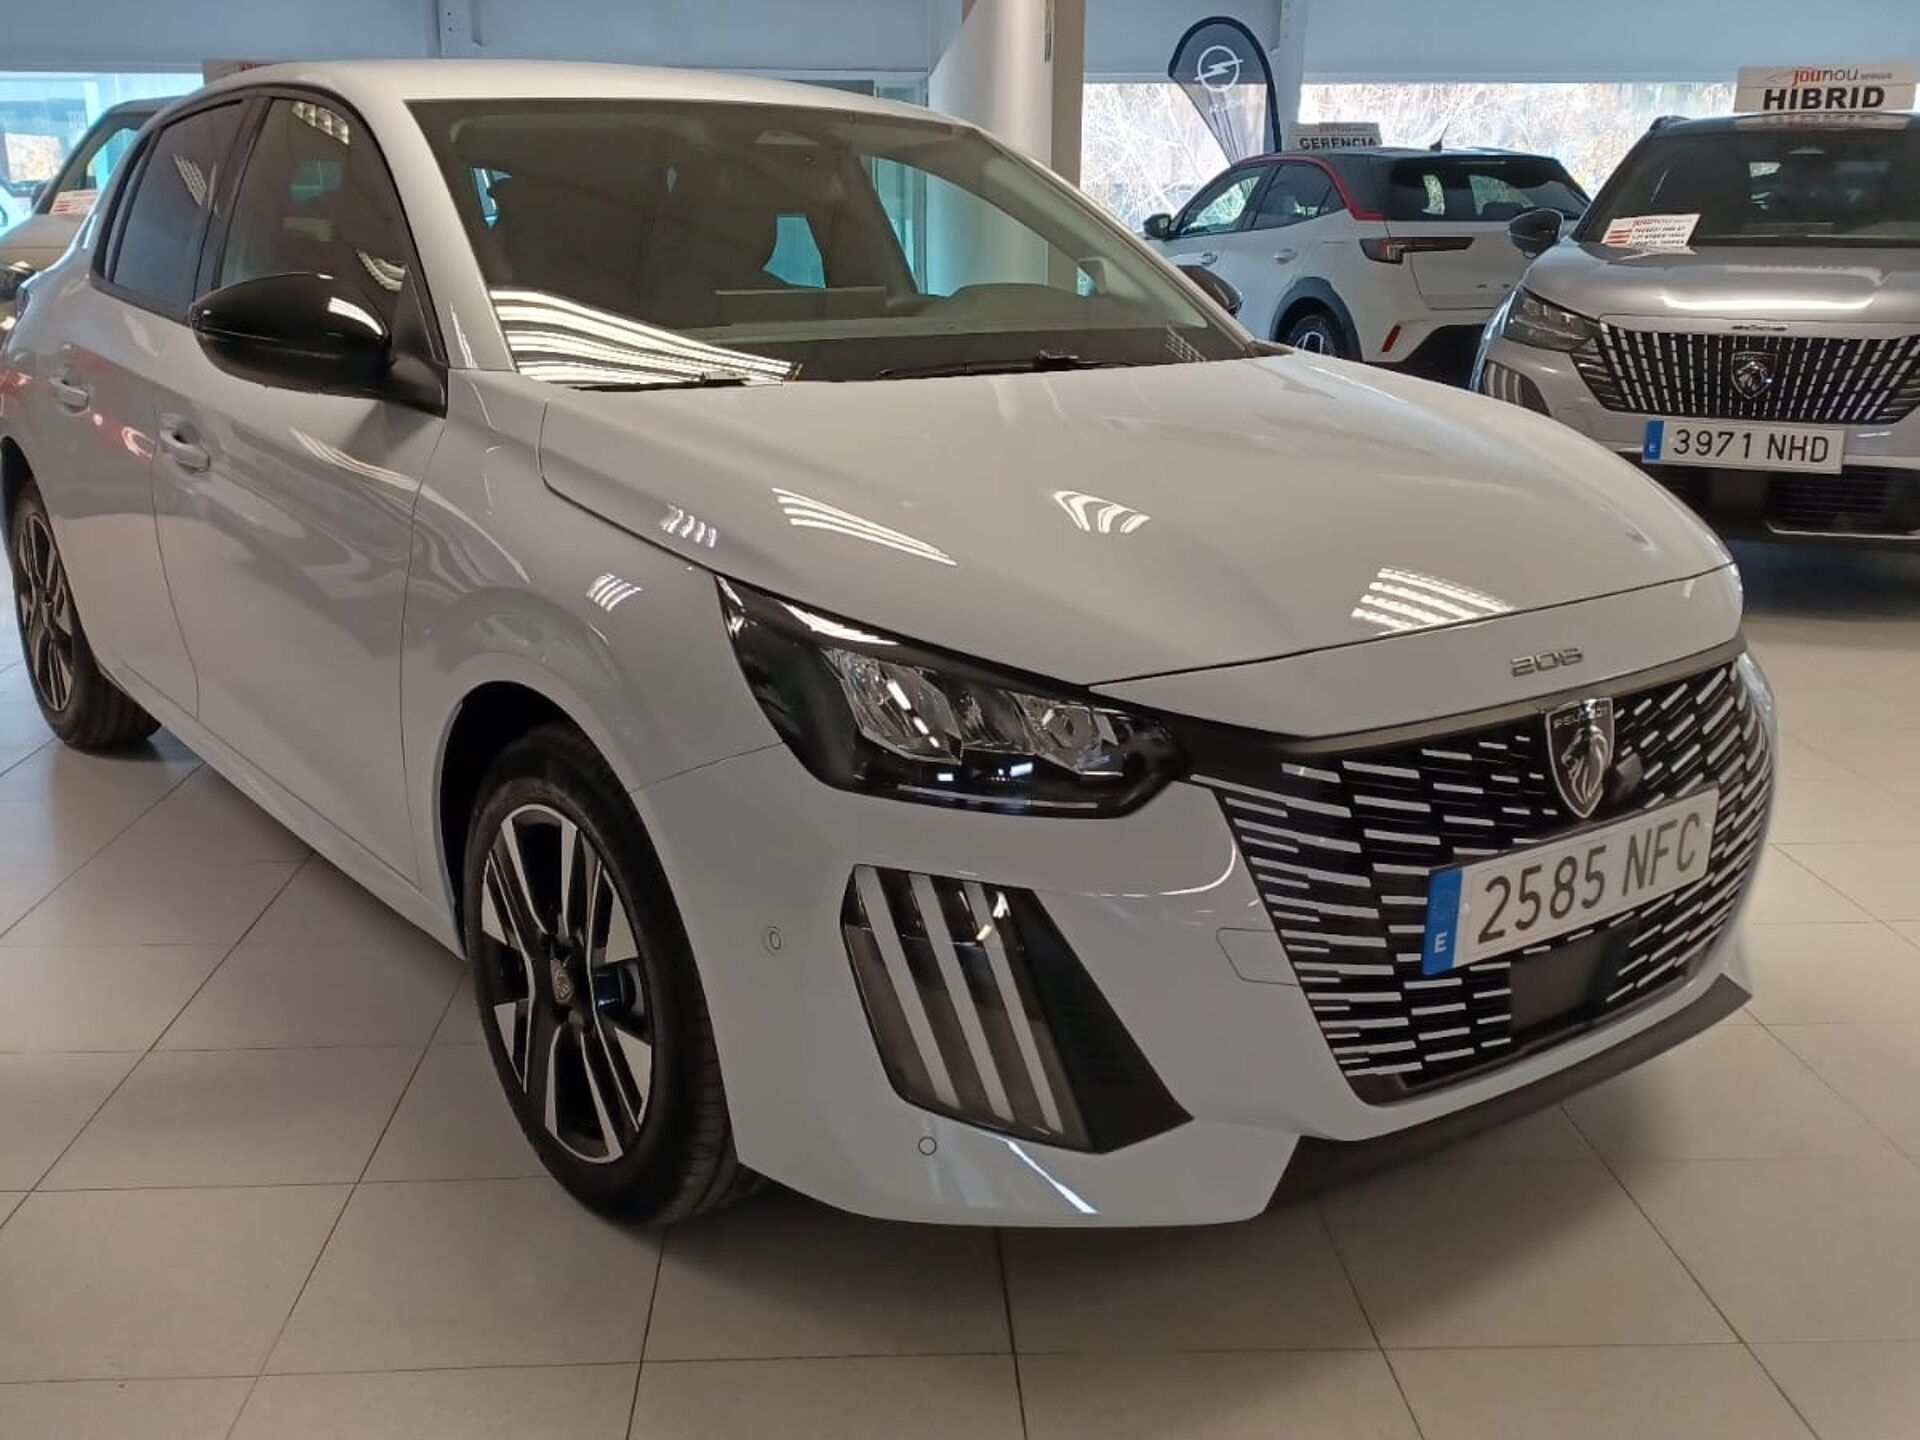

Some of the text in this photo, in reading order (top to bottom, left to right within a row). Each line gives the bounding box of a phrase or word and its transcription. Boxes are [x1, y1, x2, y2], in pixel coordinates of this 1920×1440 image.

[1763, 86, 1885, 110] HIBRID
[1300, 137, 1377, 150] GERENCIA
[1673, 428, 1752, 460] 3971
[1766, 433, 1829, 463] NHD
[1510, 647, 1583, 677] 208
[1434, 812, 1701, 953] E 2585 NFC
